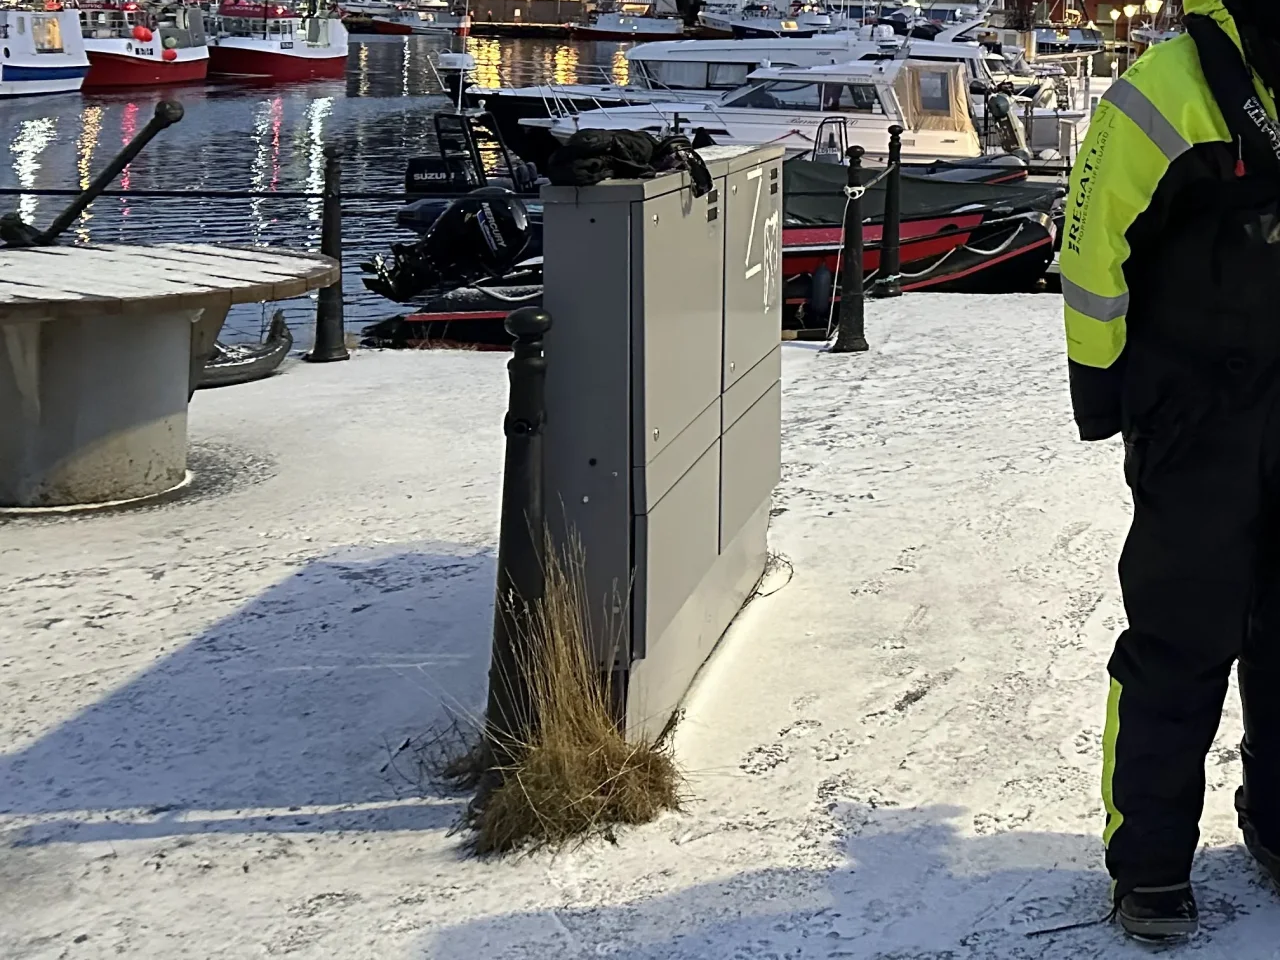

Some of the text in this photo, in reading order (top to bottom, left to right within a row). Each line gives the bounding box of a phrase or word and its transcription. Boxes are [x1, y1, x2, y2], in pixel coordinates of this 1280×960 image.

[481, 202, 507, 247] MERCURY
[1076, 131, 1109, 245] NORWEGIAN LIFEGUARD
